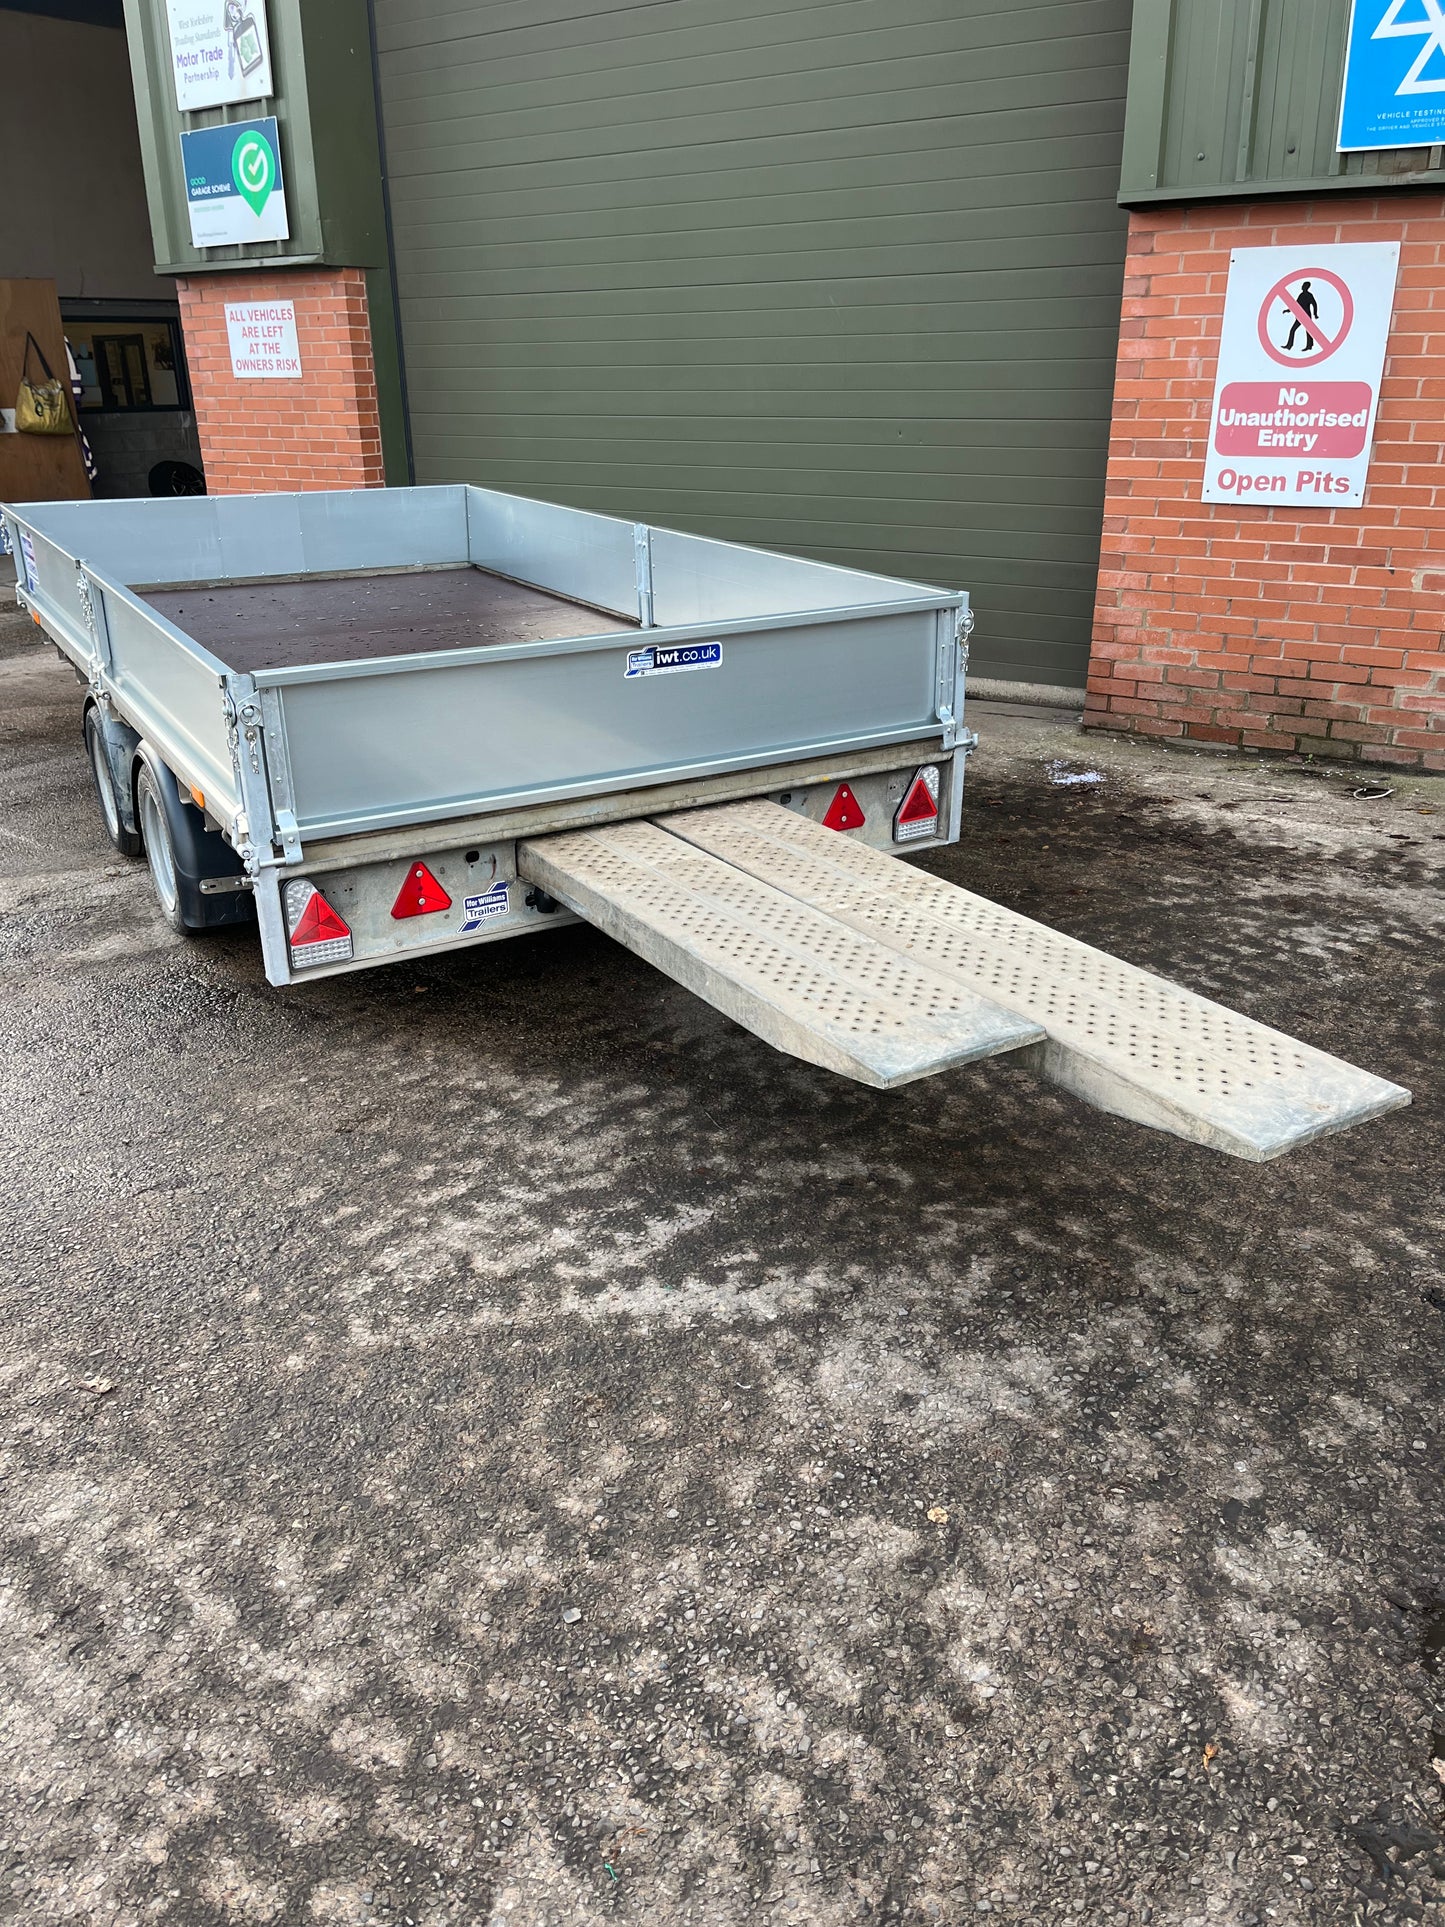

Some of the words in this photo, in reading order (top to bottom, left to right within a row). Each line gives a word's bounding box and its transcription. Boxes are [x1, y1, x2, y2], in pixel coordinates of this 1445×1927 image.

[176, 51, 199, 68] Motor
[200, 46, 224, 63] Trade
[184, 67, 220, 83] Partnership
[1377, 111, 1410, 119] VEHICLE
[190, 176, 206, 186] GOOD
[191, 186, 211, 196] GARAGE
[211, 183, 231, 194] SCHEME
[229, 310, 246, 322] ALL
[247, 308, 293, 321] VEHICLES
[242, 326, 260, 338] ARE
[261, 326, 284, 338] LEFT
[249, 343, 260, 355] AT
[262, 342, 281, 354] THE
[235, 359, 274, 371] OWNERS
[276, 359, 299, 371] RISK
[1278, 388, 1309, 406] No
[1219, 408, 1368, 427] Unauthorised
[1257, 429, 1319, 452] Entry
[1217, 468, 1287, 496] Open
[1295, 470, 1350, 494] Pits
[656, 647, 716, 664] iwt.co.uk
[478, 894, 505, 905] Williams
[468, 904, 506, 917] Trailers
